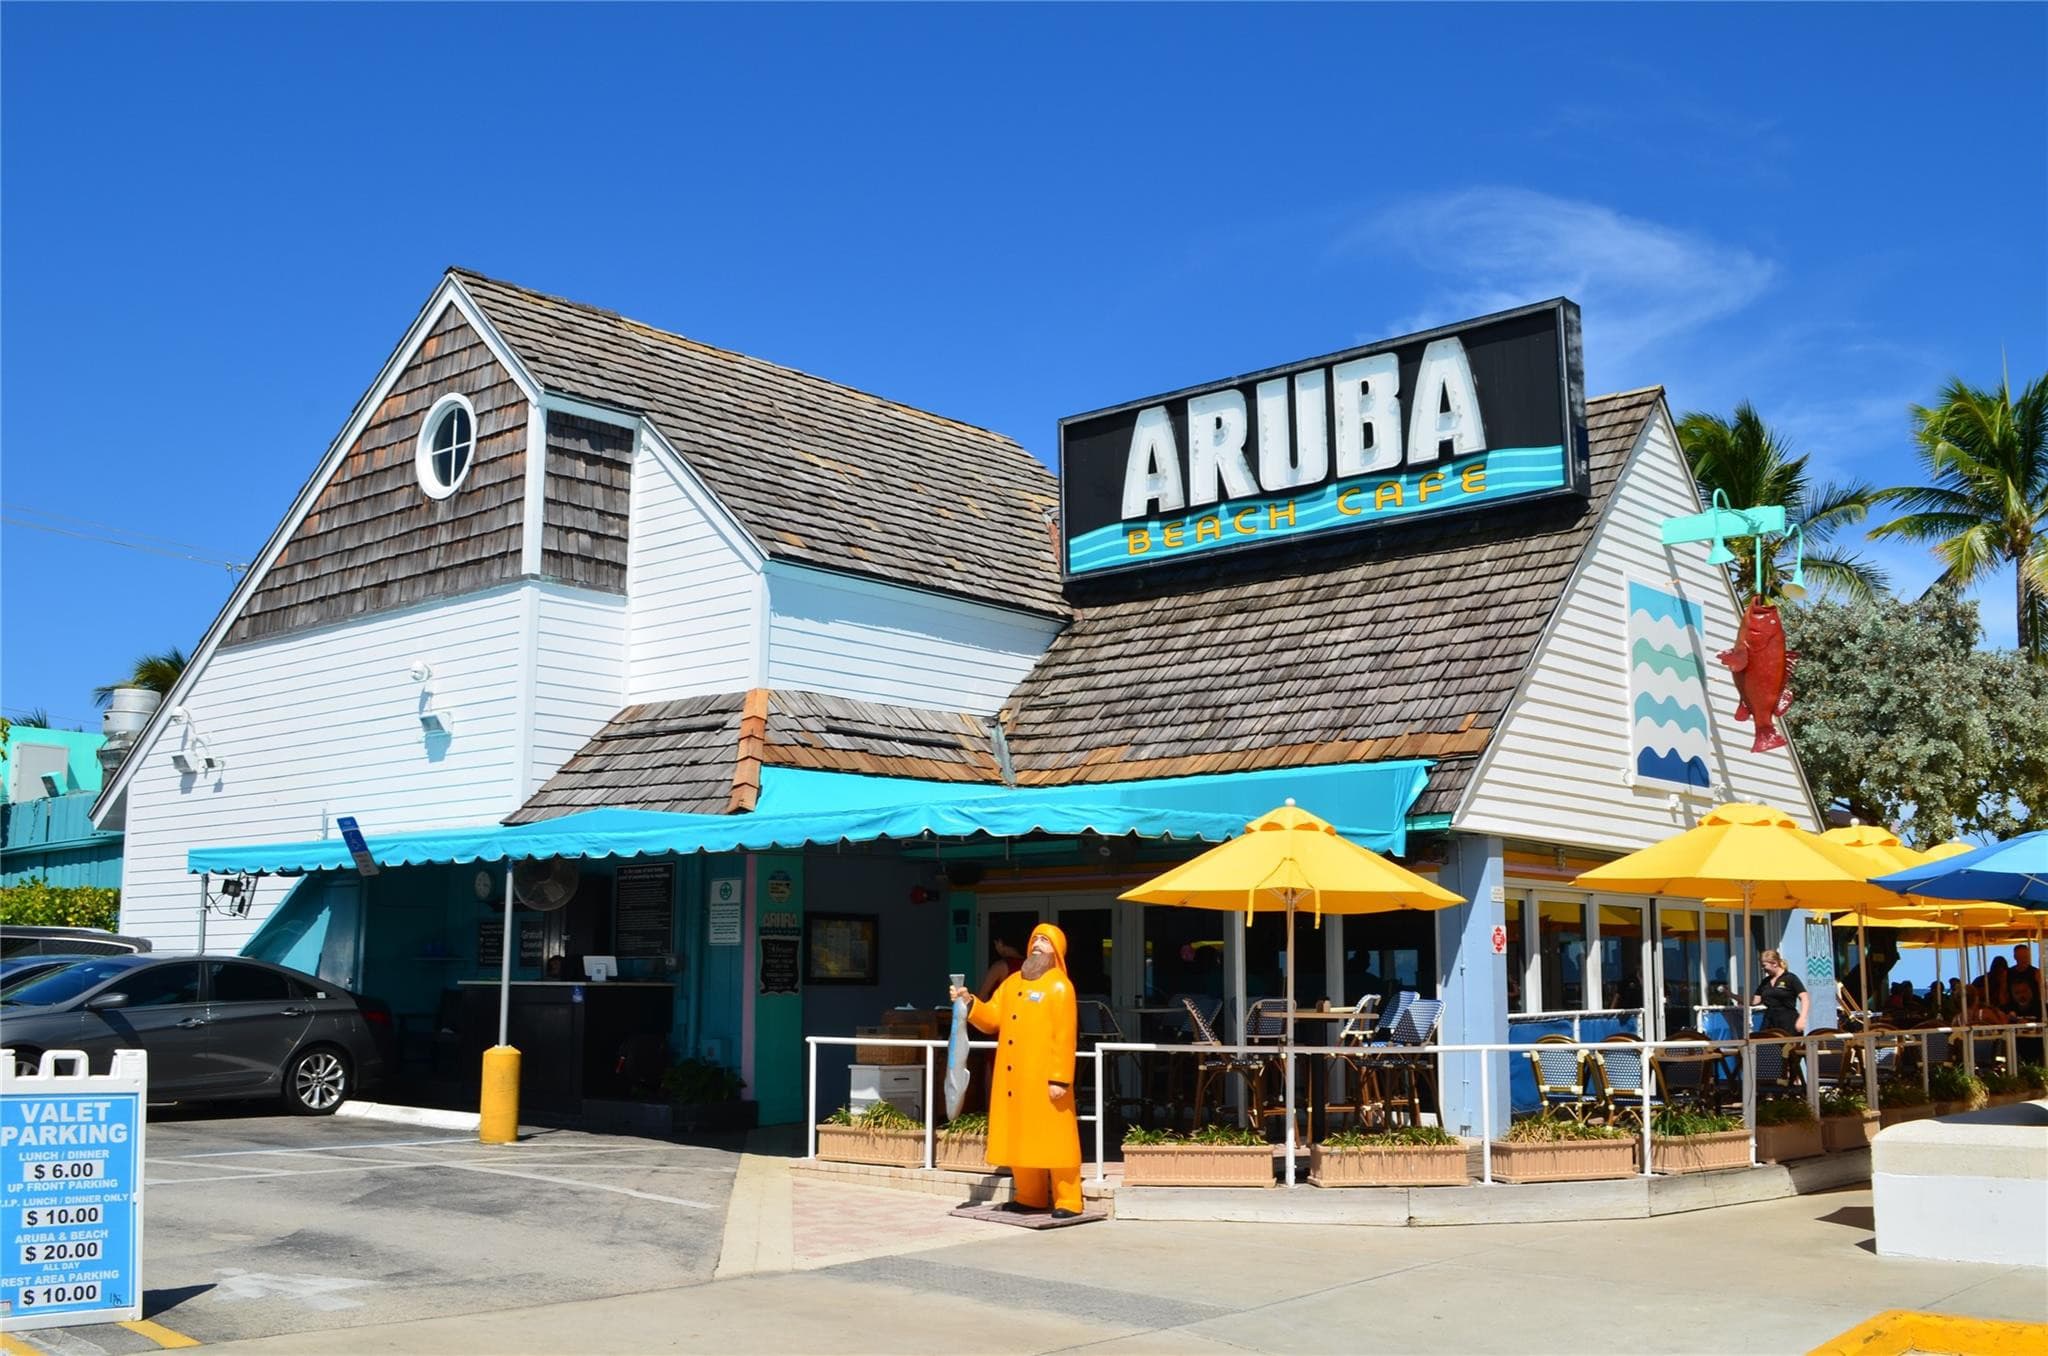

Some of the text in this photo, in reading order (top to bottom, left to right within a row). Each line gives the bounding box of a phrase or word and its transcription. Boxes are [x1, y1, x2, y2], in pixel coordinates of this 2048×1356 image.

[1121, 336, 1488, 520] ARUBA
[1127, 463, 1489, 556] BEACH CAFE
[20, 1102, 111, 1123] VALET
[0, 1123, 128, 1147] PARKING
[19, 1151, 59, 1161] LUNCH
[67, 1149, 110, 1159] DINNER
[34, 1162, 93, 1179] $ 6.00
[8, 1178, 118, 1193] UP FRONT PARKING
[23, 1196, 58, 1206] LUNCH
[65, 1194, 101, 1204] DINNER
[103, 1193, 129, 1202] ONLY
[27, 1207, 98, 1226] $ 10.00
[15, 1229, 109, 1244] ARUBA & BEACH
[25, 1242, 98, 1262] $ 20.00
[43, 1261, 81, 1272] ALL DAY
[1, 1270, 120, 1288] REST AREA PARKING
[23, 1289, 35, 1306] $
[43, 1285, 97, 1304] 10.00
